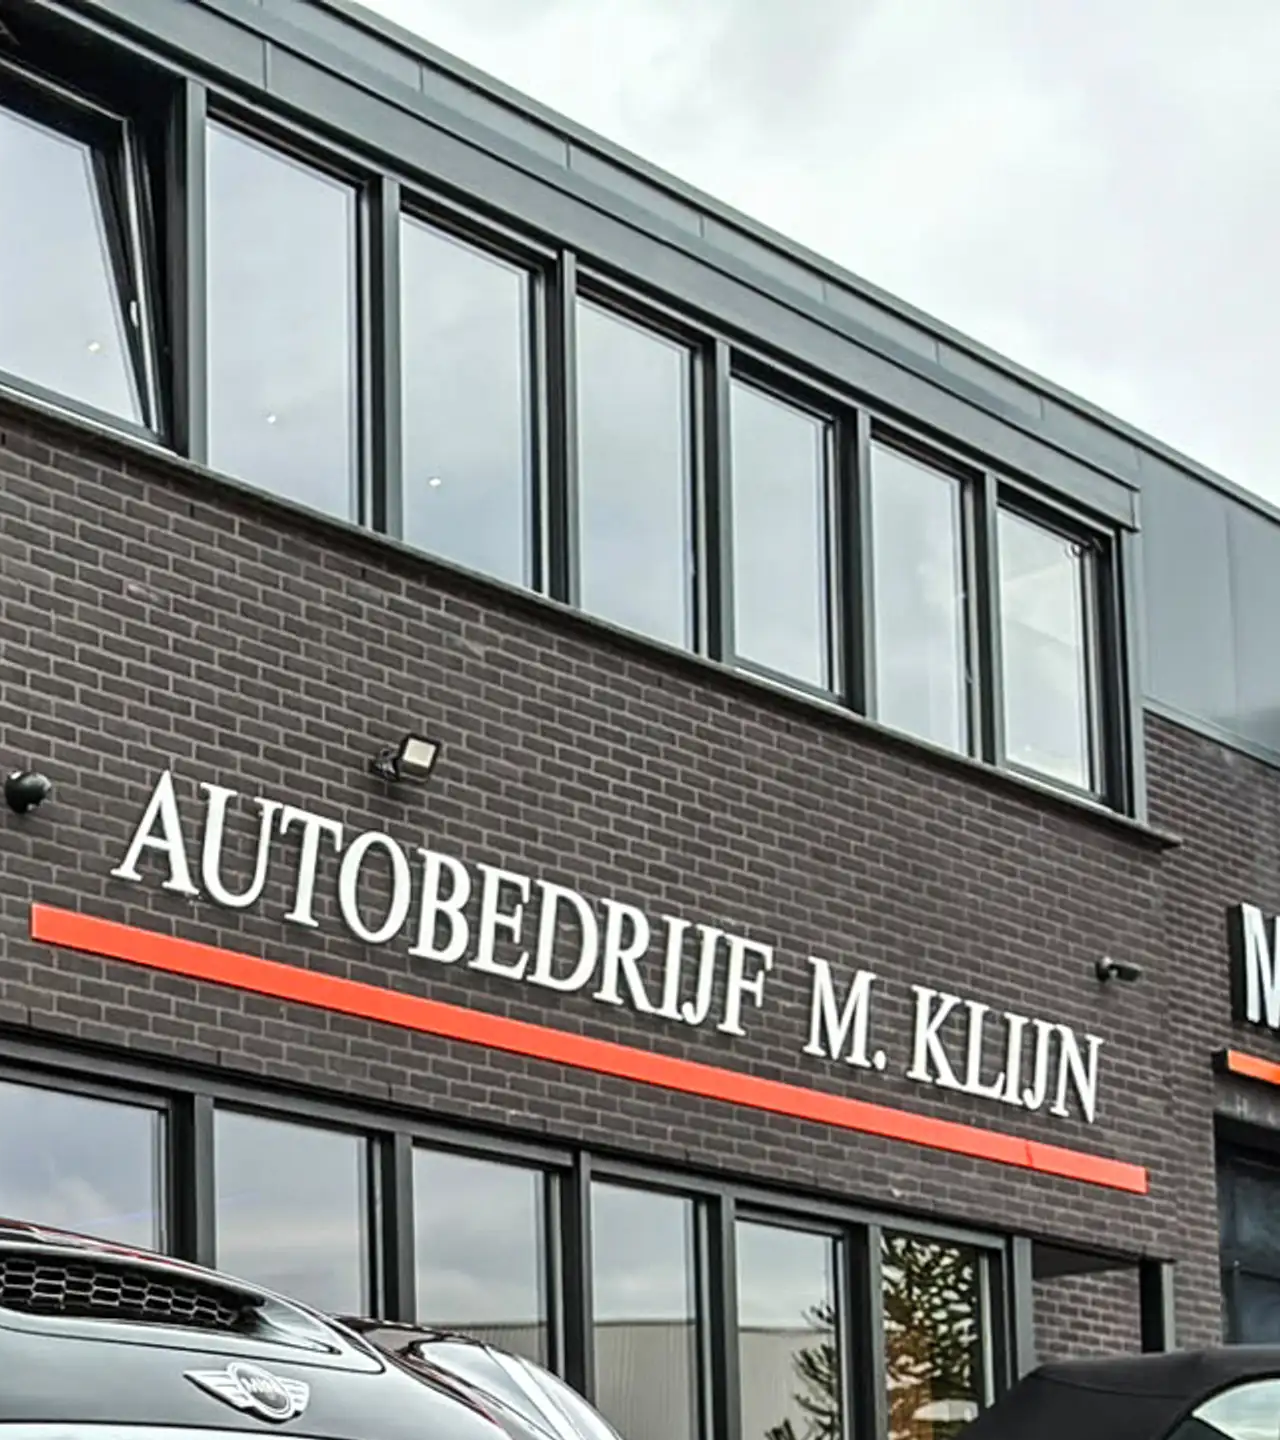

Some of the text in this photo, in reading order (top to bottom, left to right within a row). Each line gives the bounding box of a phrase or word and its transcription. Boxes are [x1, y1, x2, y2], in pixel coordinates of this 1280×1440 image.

[111, 770, 1105, 1124] AUTOBEDRIJF M. KLIJN
